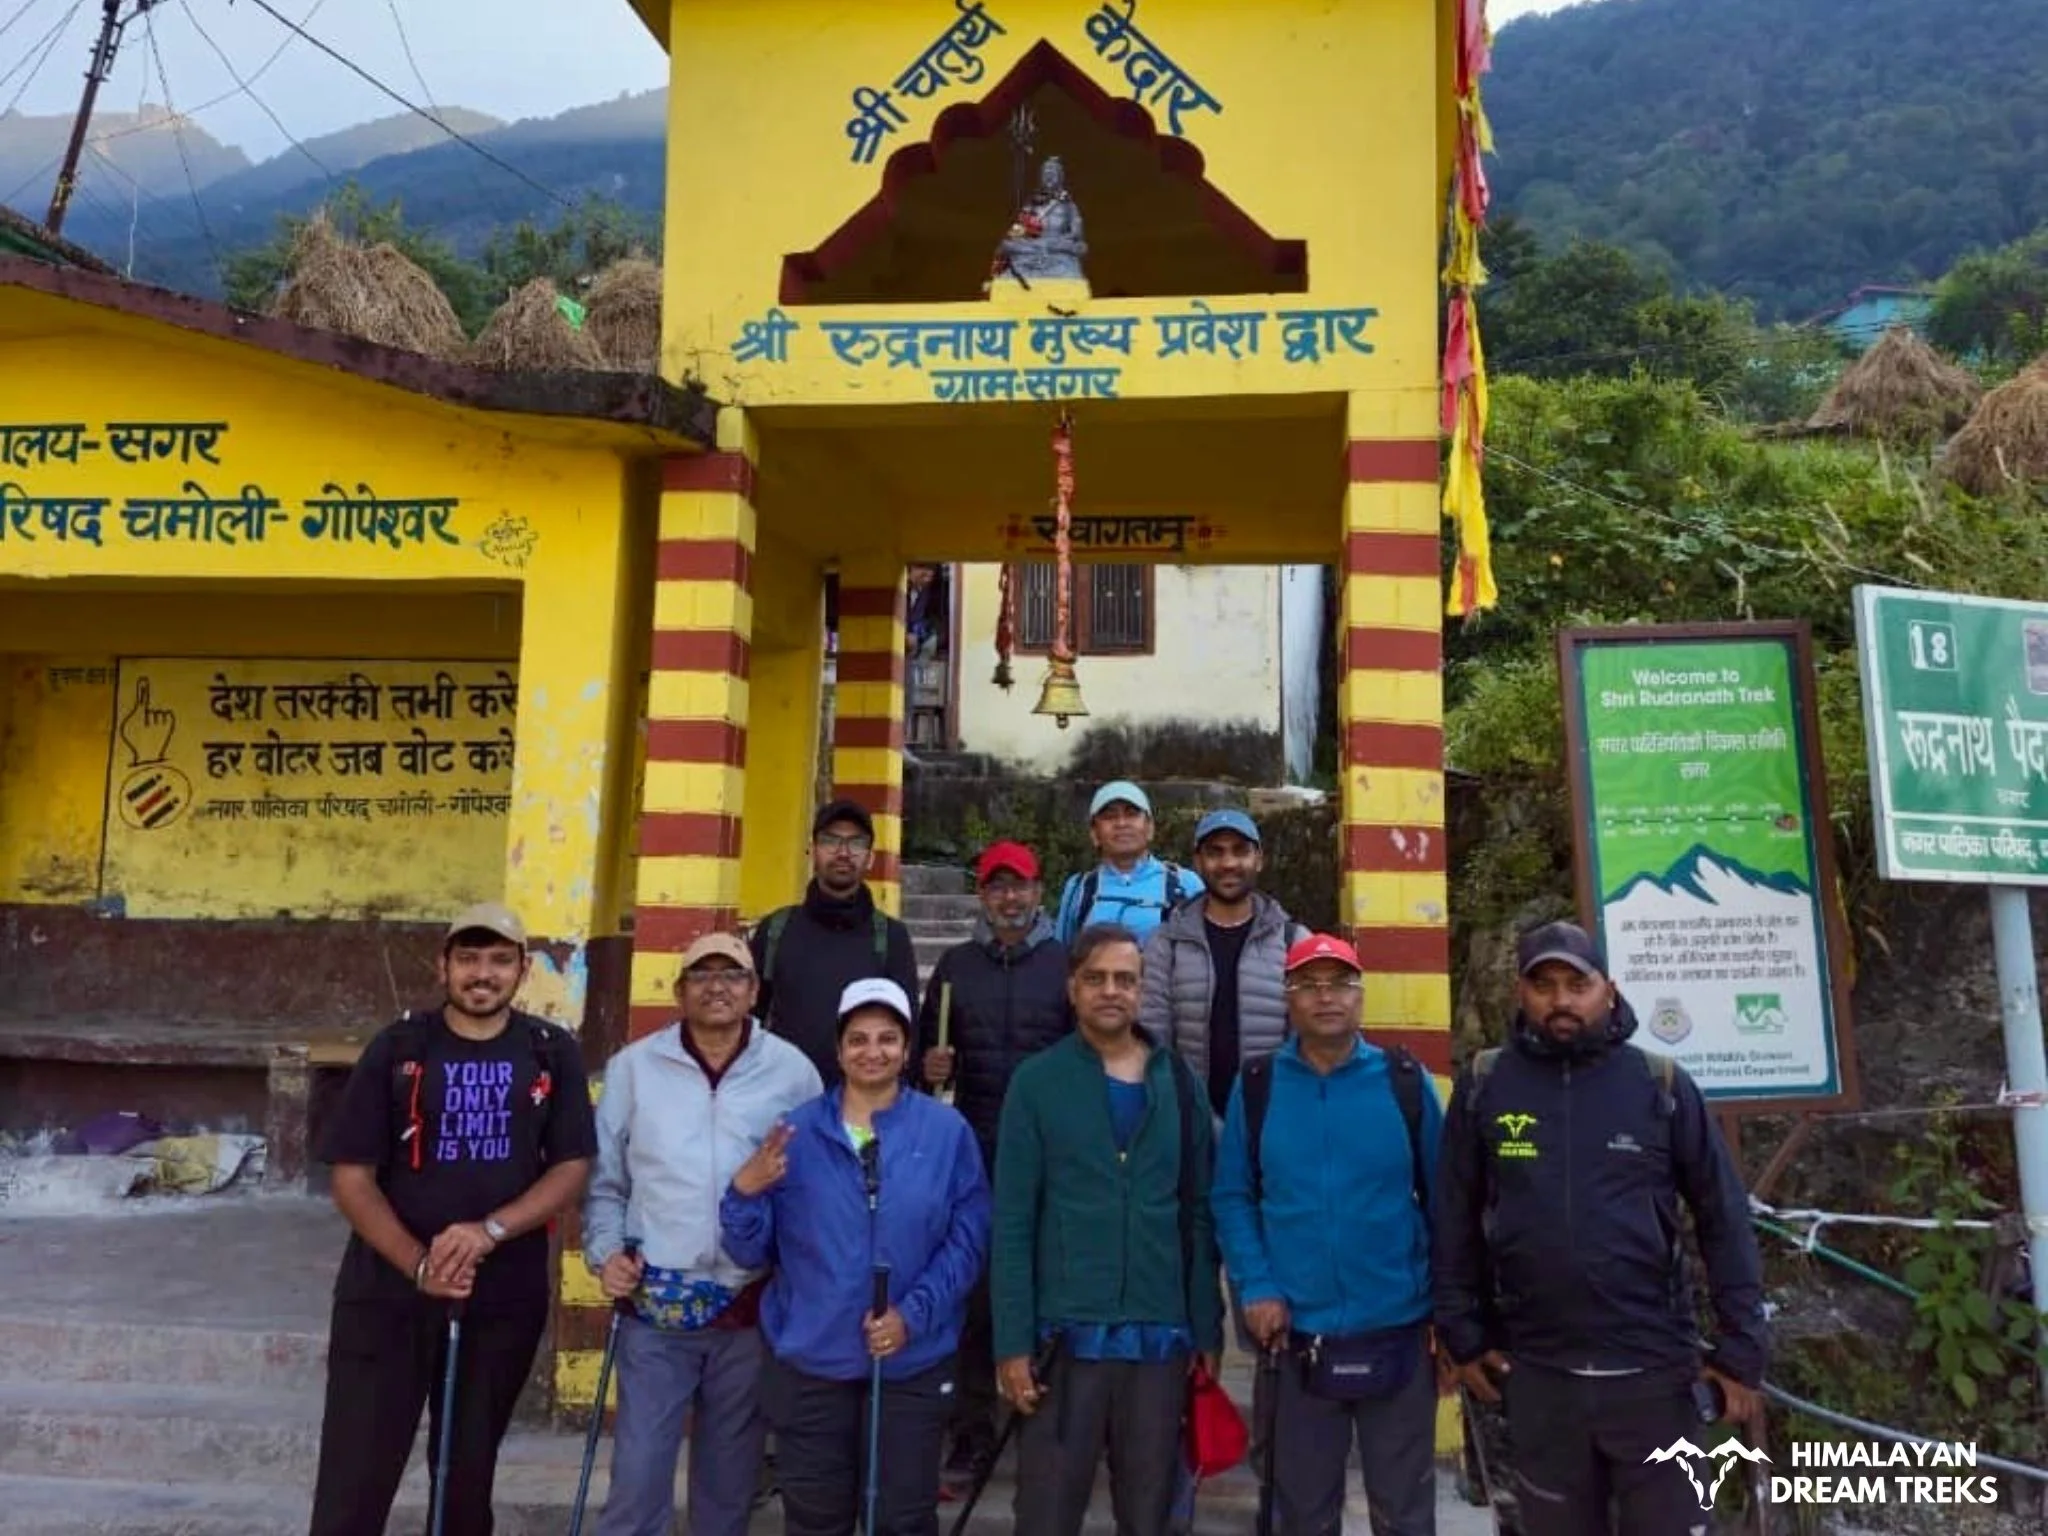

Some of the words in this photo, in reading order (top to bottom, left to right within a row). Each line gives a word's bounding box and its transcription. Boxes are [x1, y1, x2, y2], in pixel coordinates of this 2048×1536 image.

[846, 87, 909, 164] श्री
[892, 0, 1007, 98] चतुर्थ
[1085, 0, 1223, 135] केदार
[730, 308, 799, 362] श्री
[819, 320, 1018, 368] रुद्रनाथ
[1028, 316, 1140, 364] मुख्य
[1153, 300, 1267, 359] प्रवेश
[1276, 307, 1379, 362] द्वार
[301, 483, 459, 549] गोपेश्वर
[1910, 623, 1948, 669] 18
[1632, 668, 1718, 685] Welcome
[1722, 668, 1740, 683] to
[209, 673, 267, 720] देश
[273, 672, 382, 720] तरक्की
[389, 672, 458, 720] तभी
[1601, 690, 1635, 707] Shri
[1640, 687, 1734, 706] Rudranath
[1738, 686, 1775, 702] Trek
[203, 742, 246, 778] हर
[251, 728, 323, 776] वोटर
[329, 742, 387, 775] जब
[393, 728, 456, 775] वोट
[207, 800, 246, 820] नगर
[250, 790, 308, 819] पालिका
[443, 1062, 513, 1086] YOUR
[445, 1086, 509, 1112] ONLY
[440, 1112, 512, 1137] LIMIT
[437, 1140, 459, 1161] IS
[467, 1137, 511, 1161] YOU
